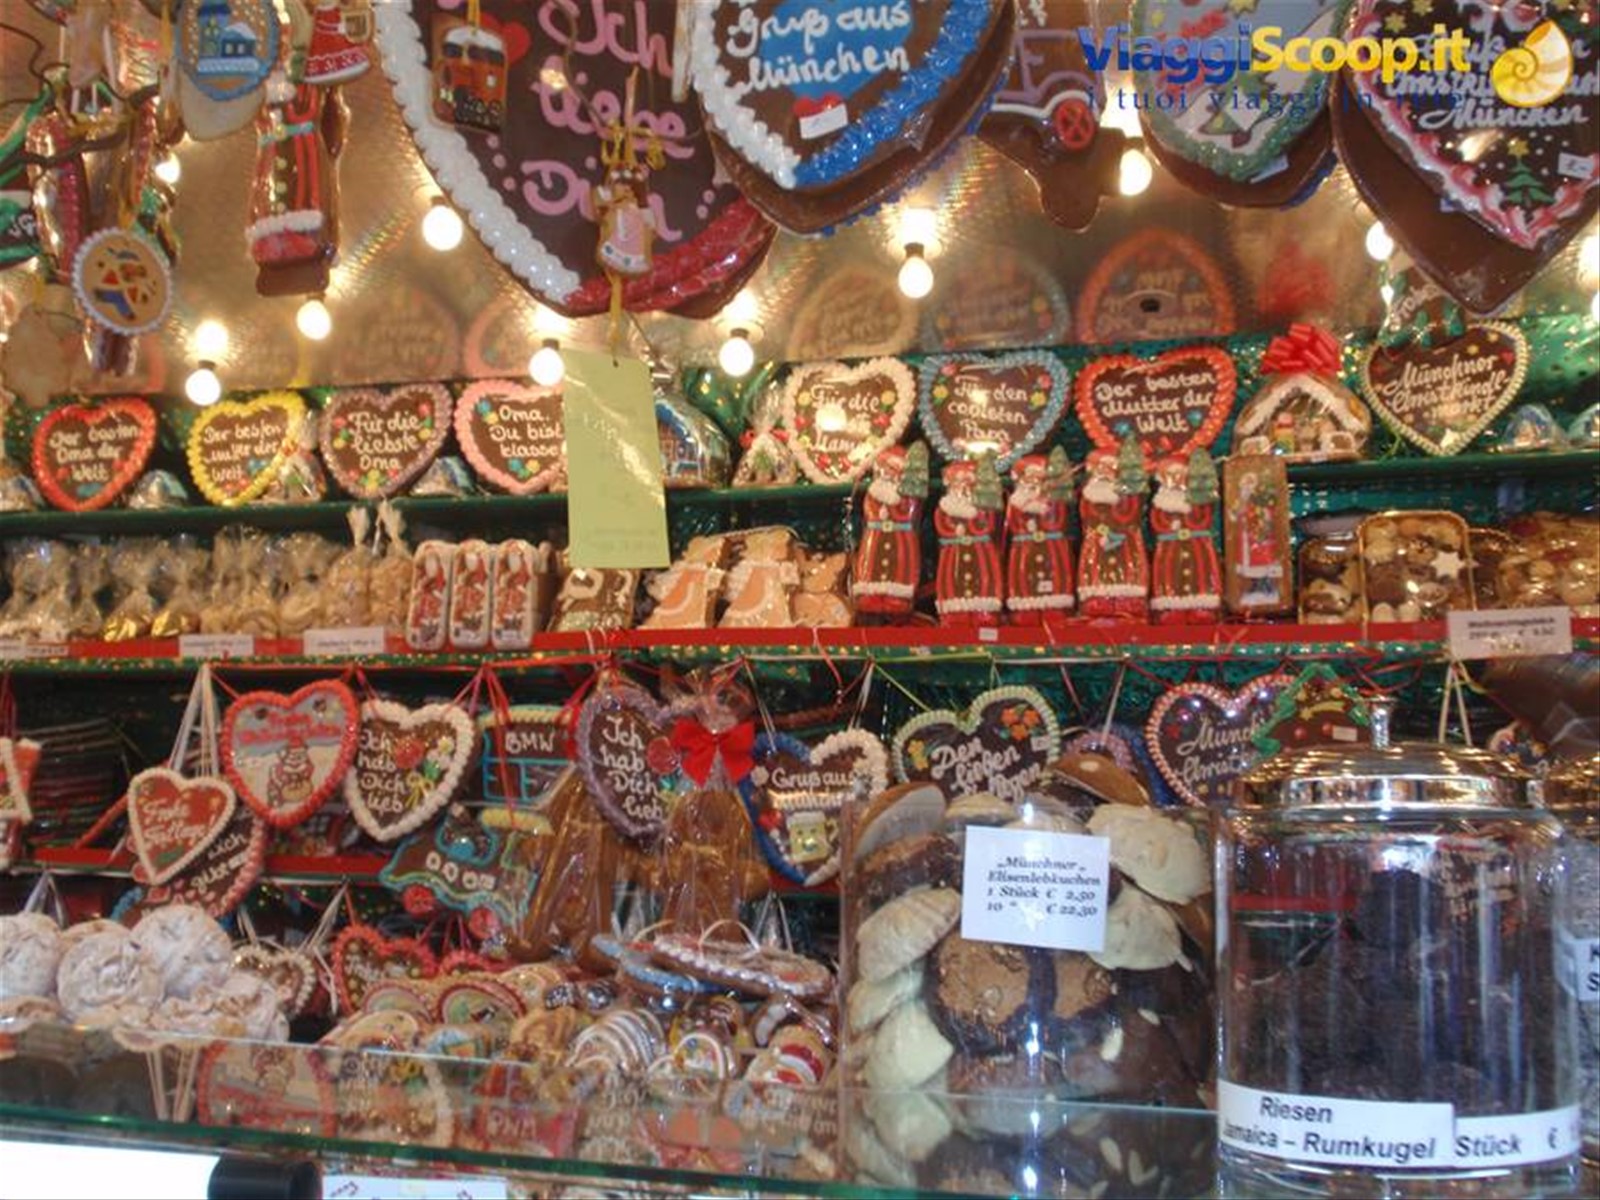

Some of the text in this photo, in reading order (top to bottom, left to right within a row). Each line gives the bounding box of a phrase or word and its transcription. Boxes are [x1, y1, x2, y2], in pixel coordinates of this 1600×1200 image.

[836, 2, 911, 31] aus
[993, 382, 1028, 402] den
[387, 411, 422, 432] die
[527, 421, 564, 440] bist
[505, 727, 555, 754] BMW
[602, 715, 645, 750] Ich
[599, 744, 645, 772] hab
[1000, 885, 1039, 898] Stück
[1259, 1096, 1333, 1123] Riesen
[1303, 1132, 1436, 1164] Rumkugel
[1455, 1134, 1522, 1158] Stück
